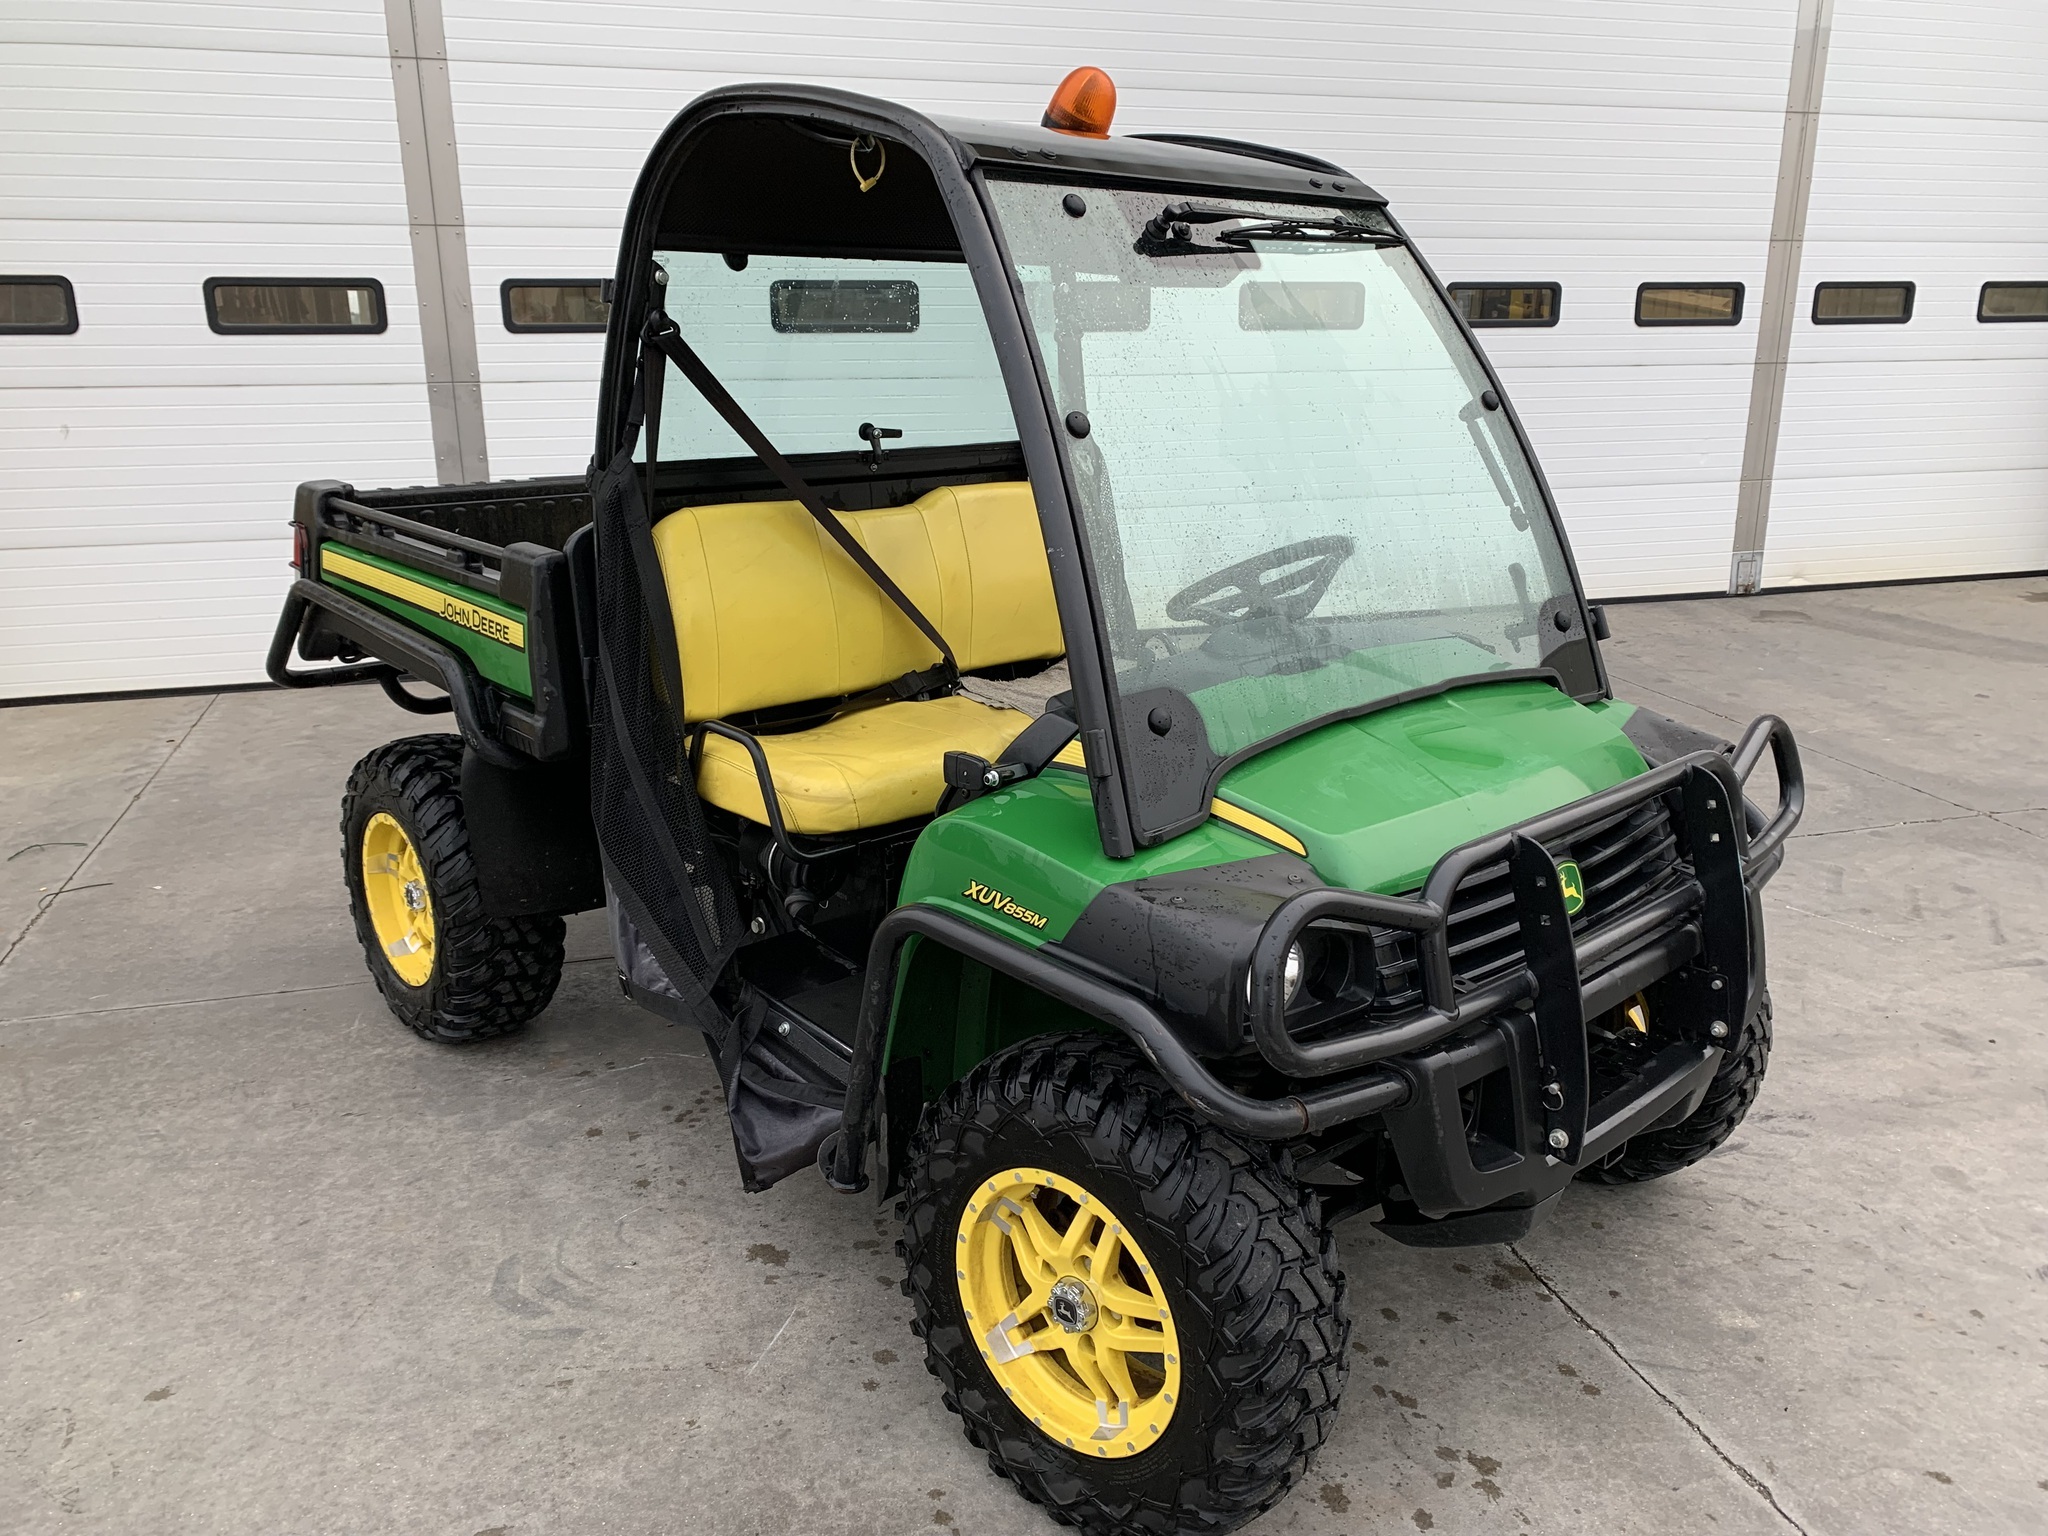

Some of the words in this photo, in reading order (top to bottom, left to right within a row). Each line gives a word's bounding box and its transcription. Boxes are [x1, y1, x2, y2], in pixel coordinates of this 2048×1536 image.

[440, 598, 470, 625] JOHN
[472, 609, 510, 641] DEERE
[962, 879, 1049, 930] XUV855M
